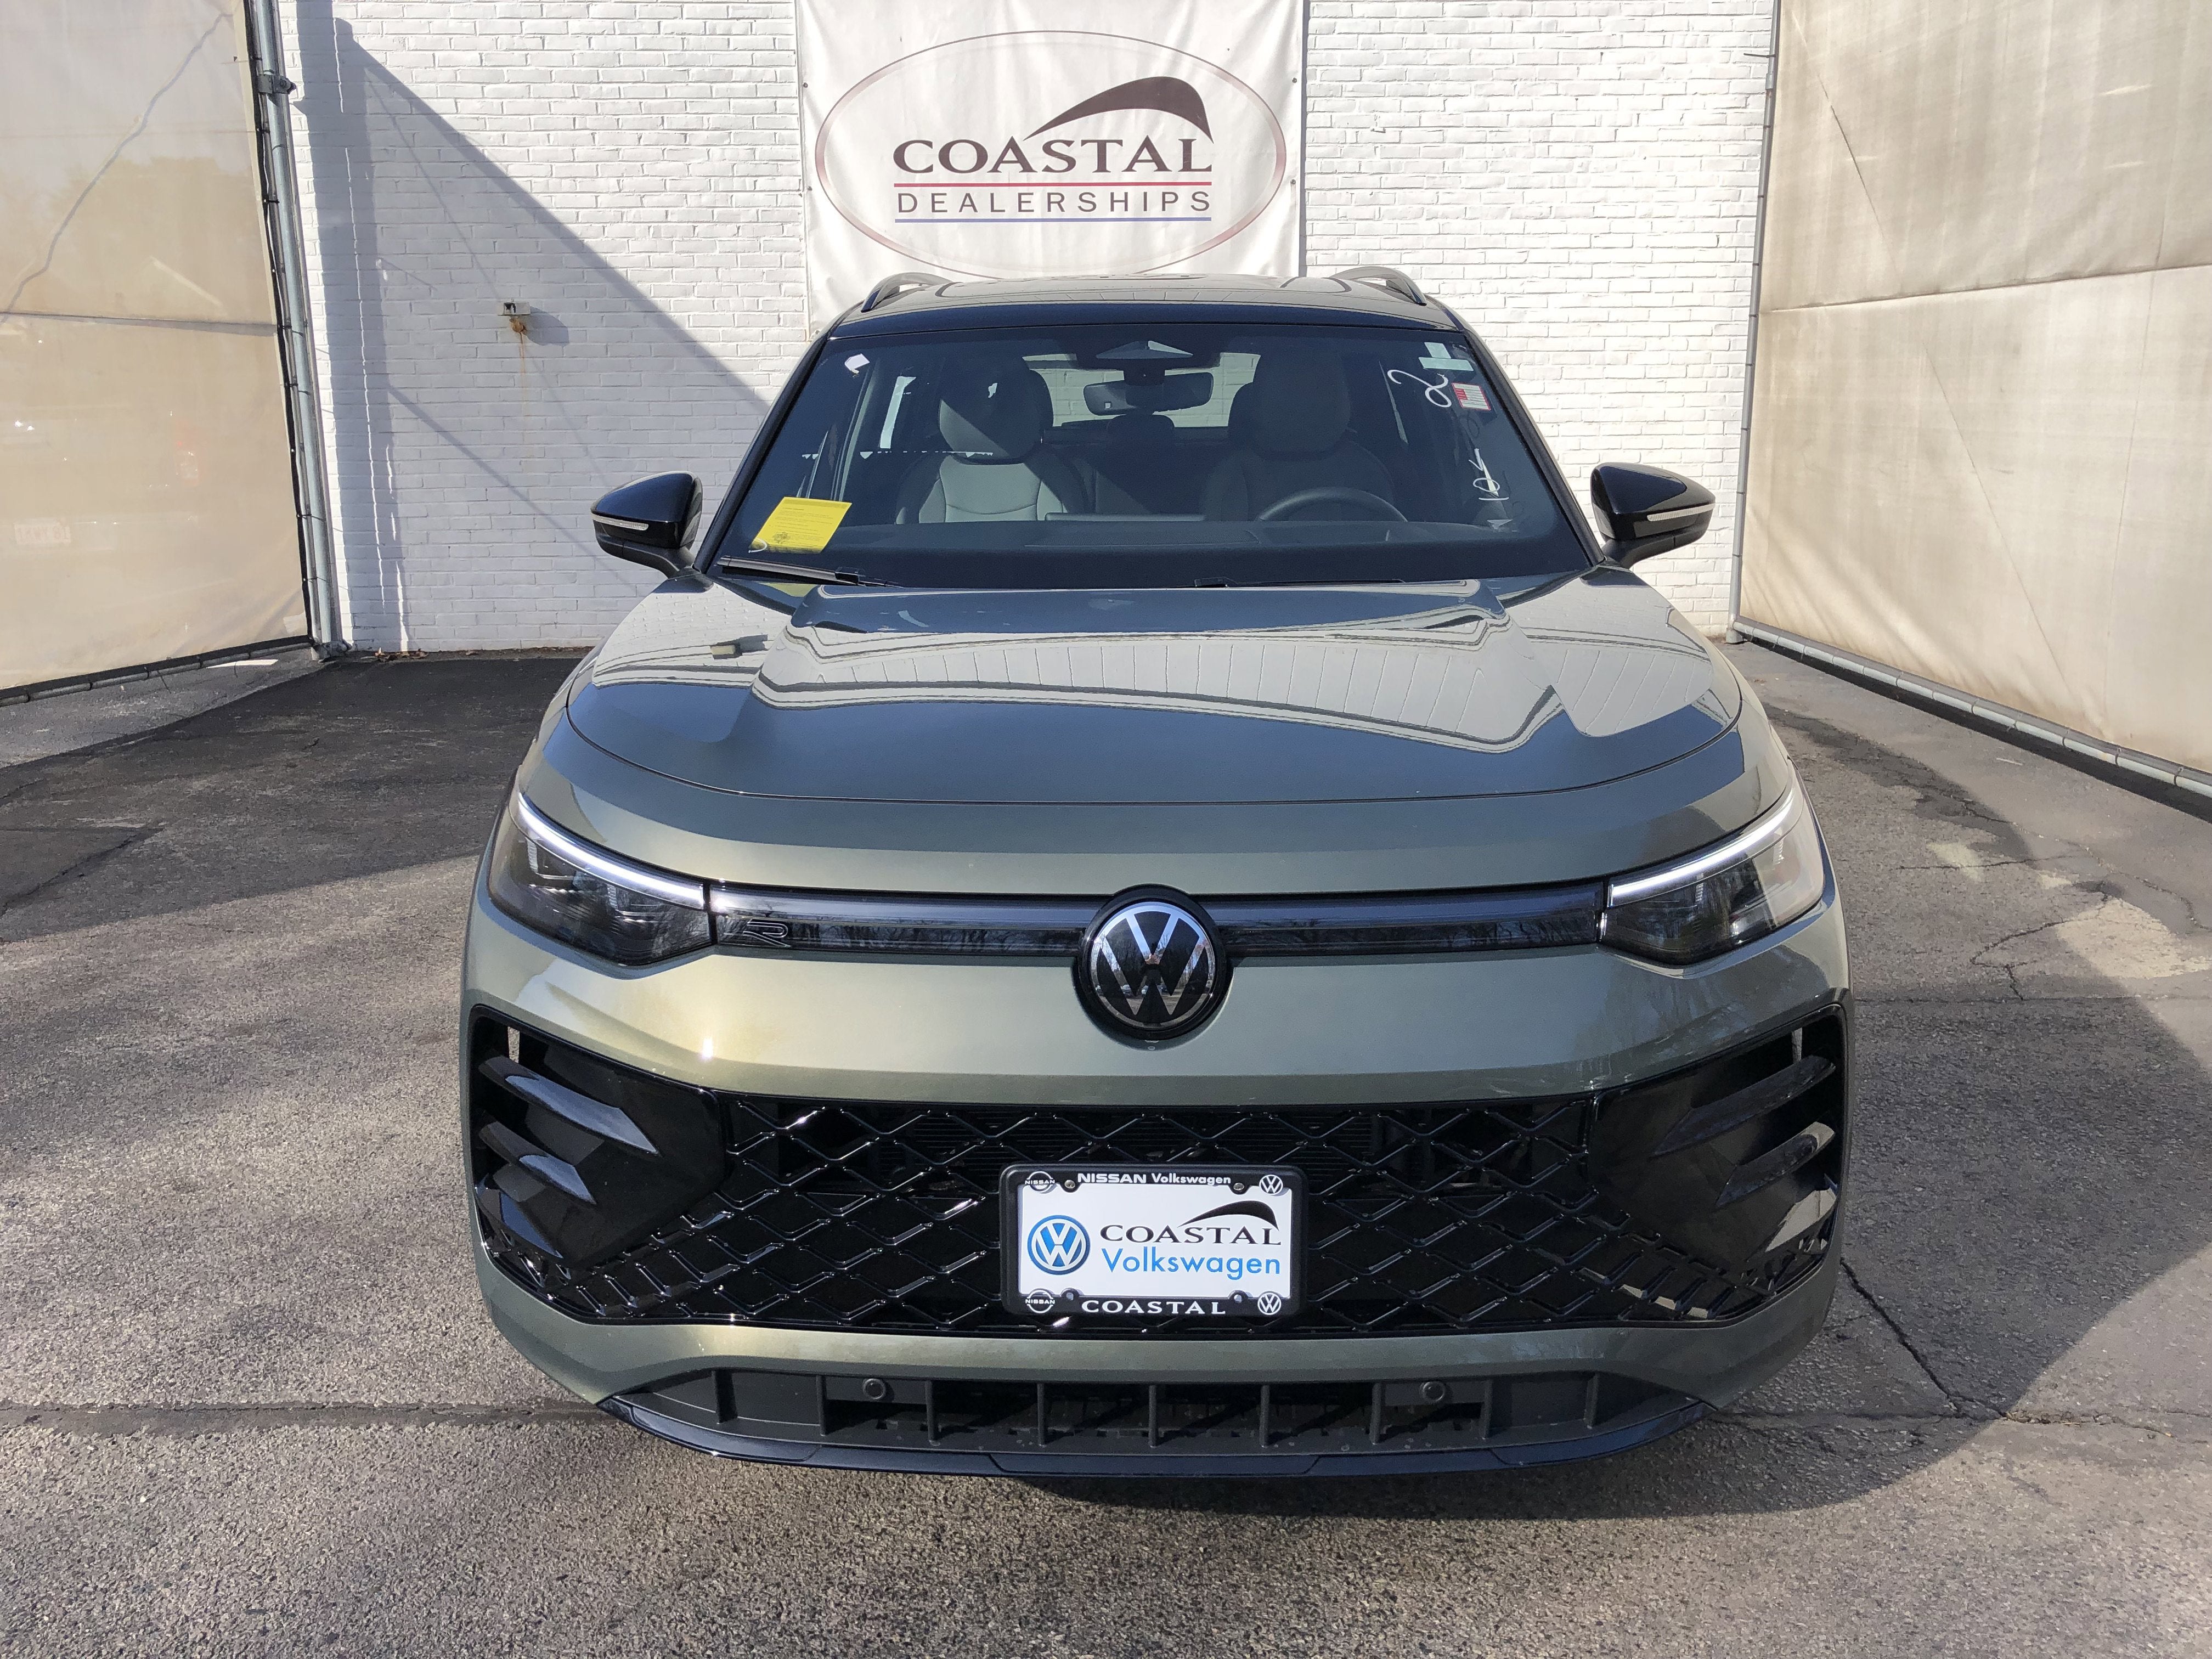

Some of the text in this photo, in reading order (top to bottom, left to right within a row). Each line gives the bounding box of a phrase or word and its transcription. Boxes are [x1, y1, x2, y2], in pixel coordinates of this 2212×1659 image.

[893, 135, 1212, 174] COASTAL
[898, 191, 1210, 213] DEALERSHIPS
[1077, 1172, 1232, 1186] NISSAN Volkswagen
[1100, 1224, 1282, 1245] COASTAL
[1102, 1246, 1281, 1280] Volkswagen
[1081, 1300, 1226, 1315] COASTAL
